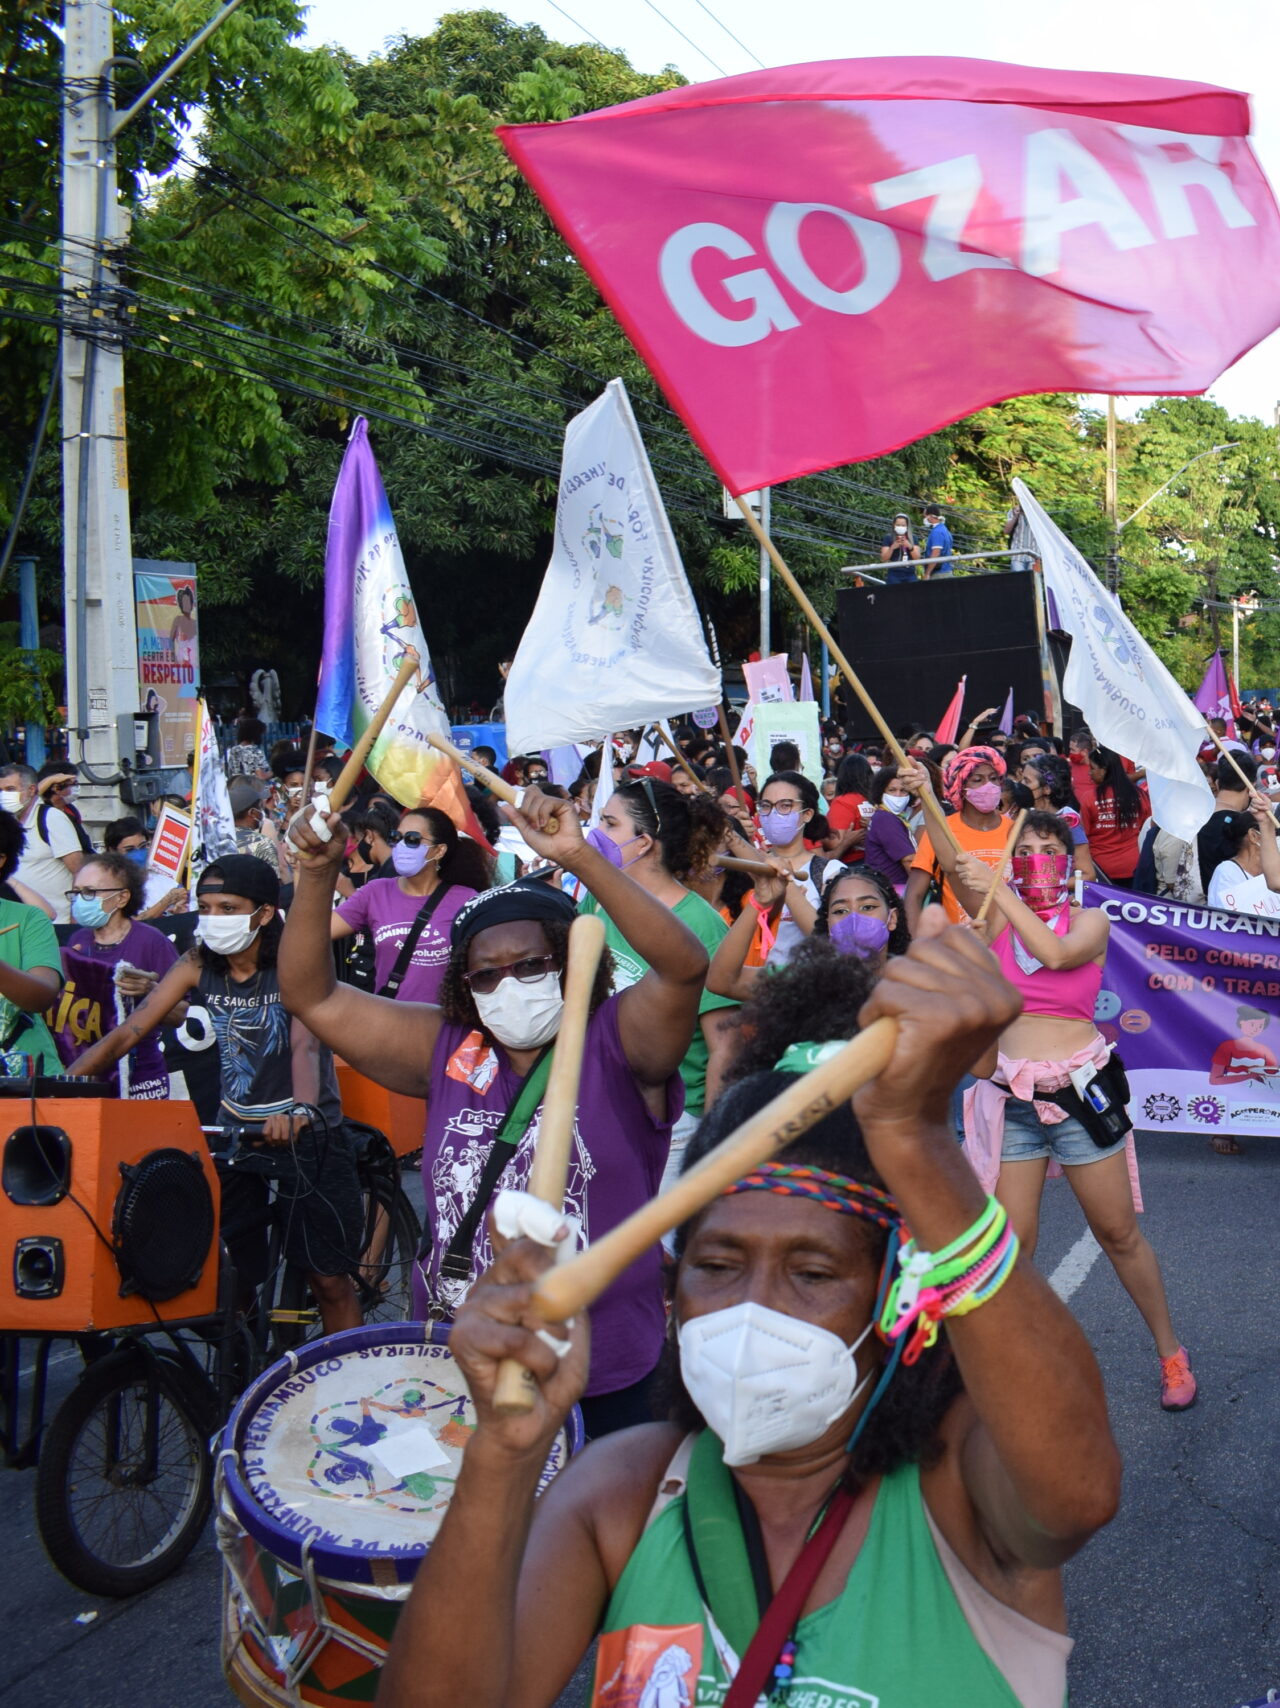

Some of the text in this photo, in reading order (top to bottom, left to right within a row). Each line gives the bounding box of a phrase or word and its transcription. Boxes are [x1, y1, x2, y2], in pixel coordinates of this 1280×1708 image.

[658, 126, 1257, 348] GOZAR
[143, 651, 164, 661] CERTA
[143, 662, 195, 684] RESPEITO
[1146, 943, 1198, 962] PELO
[1149, 974, 1194, 991] COM
[1202, 977, 1216, 993] O
[224, 995, 260, 1008] SAVAGE
[467, 1112, 494, 1127] PELA
[248, 1356, 344, 1453] PERNAMBUCO
[244, 1452, 264, 1481] DE
